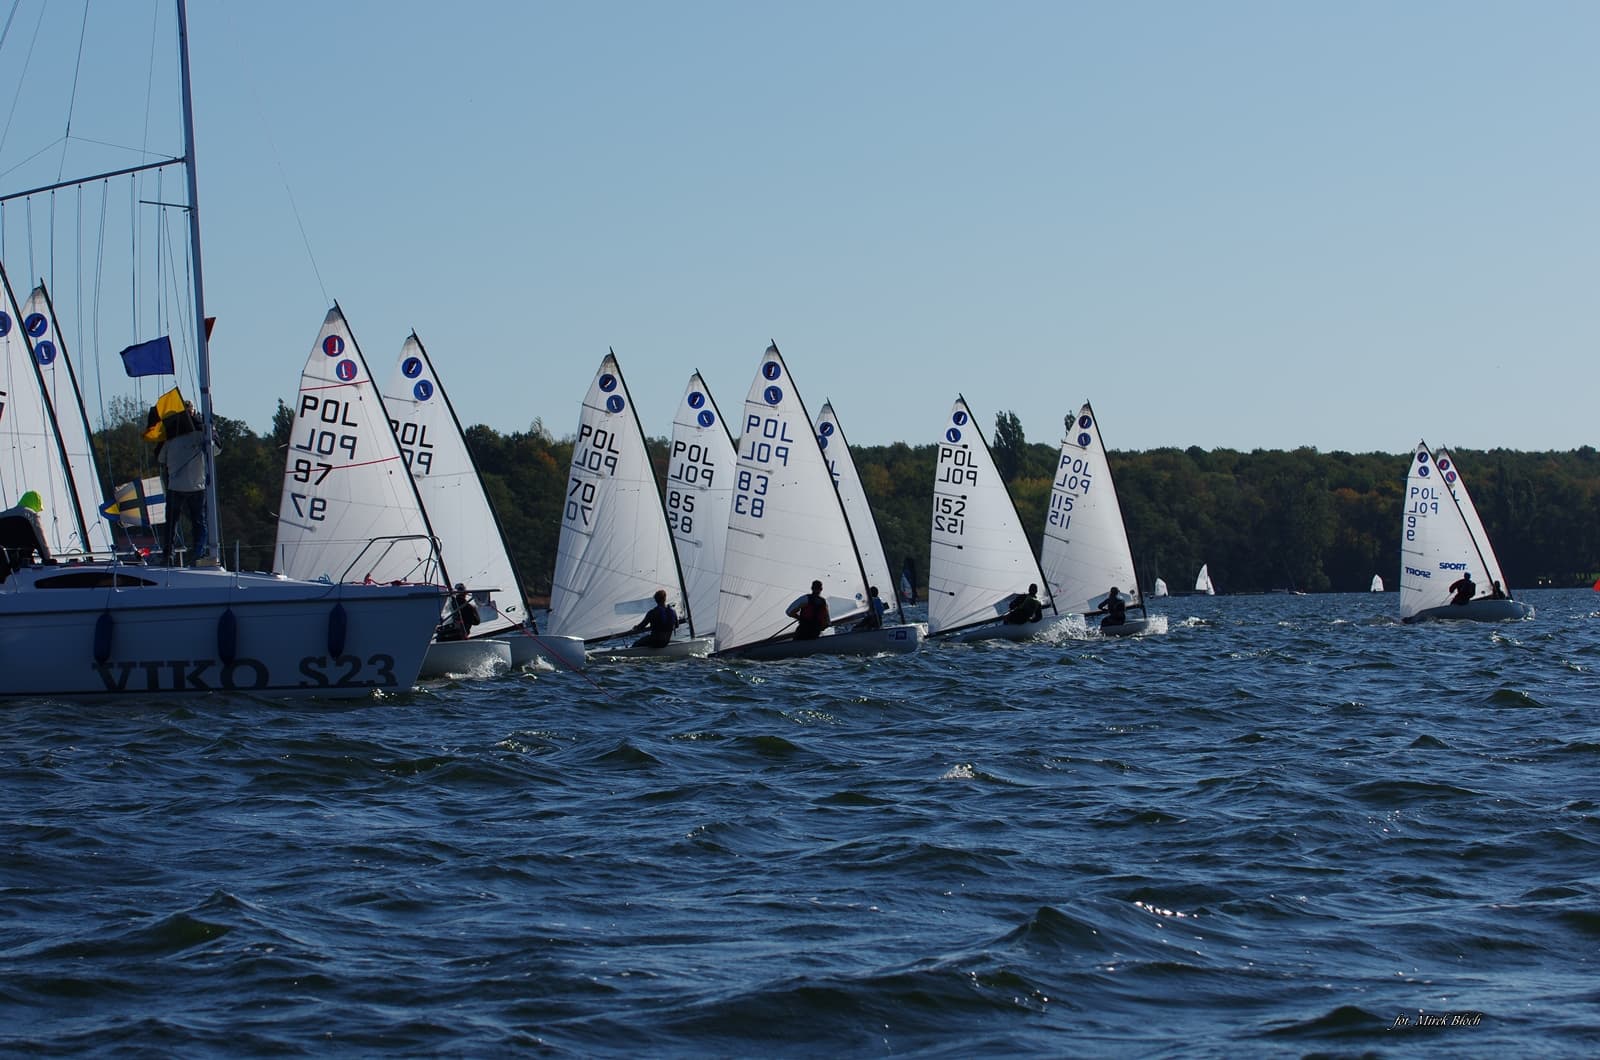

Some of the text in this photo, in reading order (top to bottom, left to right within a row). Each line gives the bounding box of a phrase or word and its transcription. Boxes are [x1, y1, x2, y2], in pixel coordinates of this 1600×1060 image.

[300, 395, 358, 427] POL
[579, 424, 619, 454] POL
[746, 414, 793, 443] POL
[673, 440, 714, 467] POL
[940, 448, 978, 468] POL
[294, 458, 333, 486] 97
[1060, 455, 1092, 478] POL
[569, 478, 596, 504] 70
[737, 470, 769, 496] 83
[1411, 487, 1439, 500] POL
[669, 491, 695, 513] 85
[935, 497, 966, 517] 152
[1051, 494, 1074, 512] 115
[1407, 516, 1416, 528] 9
[1439, 562, 1467, 571] SPORT
[92, 653, 399, 691] VIKO S23
